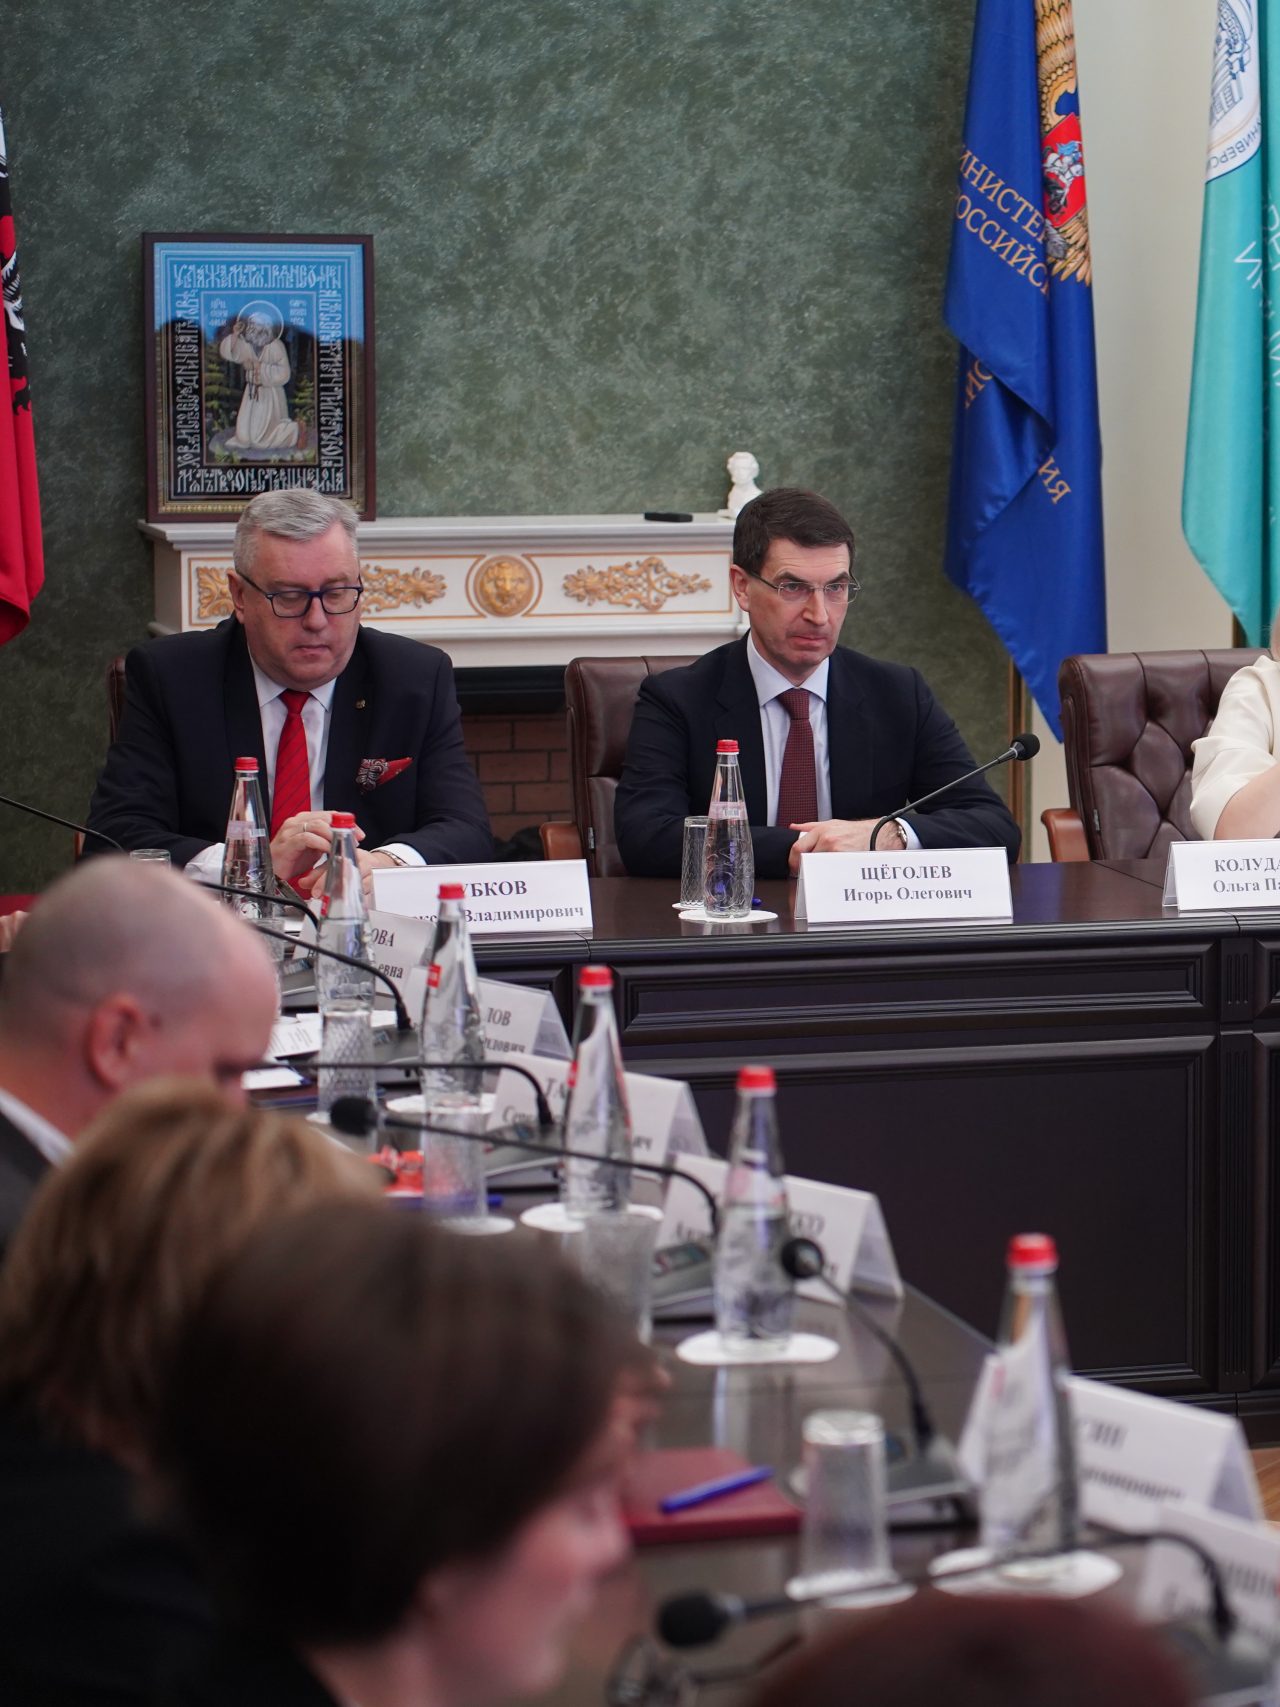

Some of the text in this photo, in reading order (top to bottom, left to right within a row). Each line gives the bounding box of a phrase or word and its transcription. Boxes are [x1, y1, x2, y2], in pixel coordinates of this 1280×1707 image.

[860, 863, 952, 882] ЩЁГОЛЕВ
[843, 886, 973, 905] Игорь Олегович
[1212, 879, 1261, 894] Ольга
[464, 907, 585, 924] Владимирович
